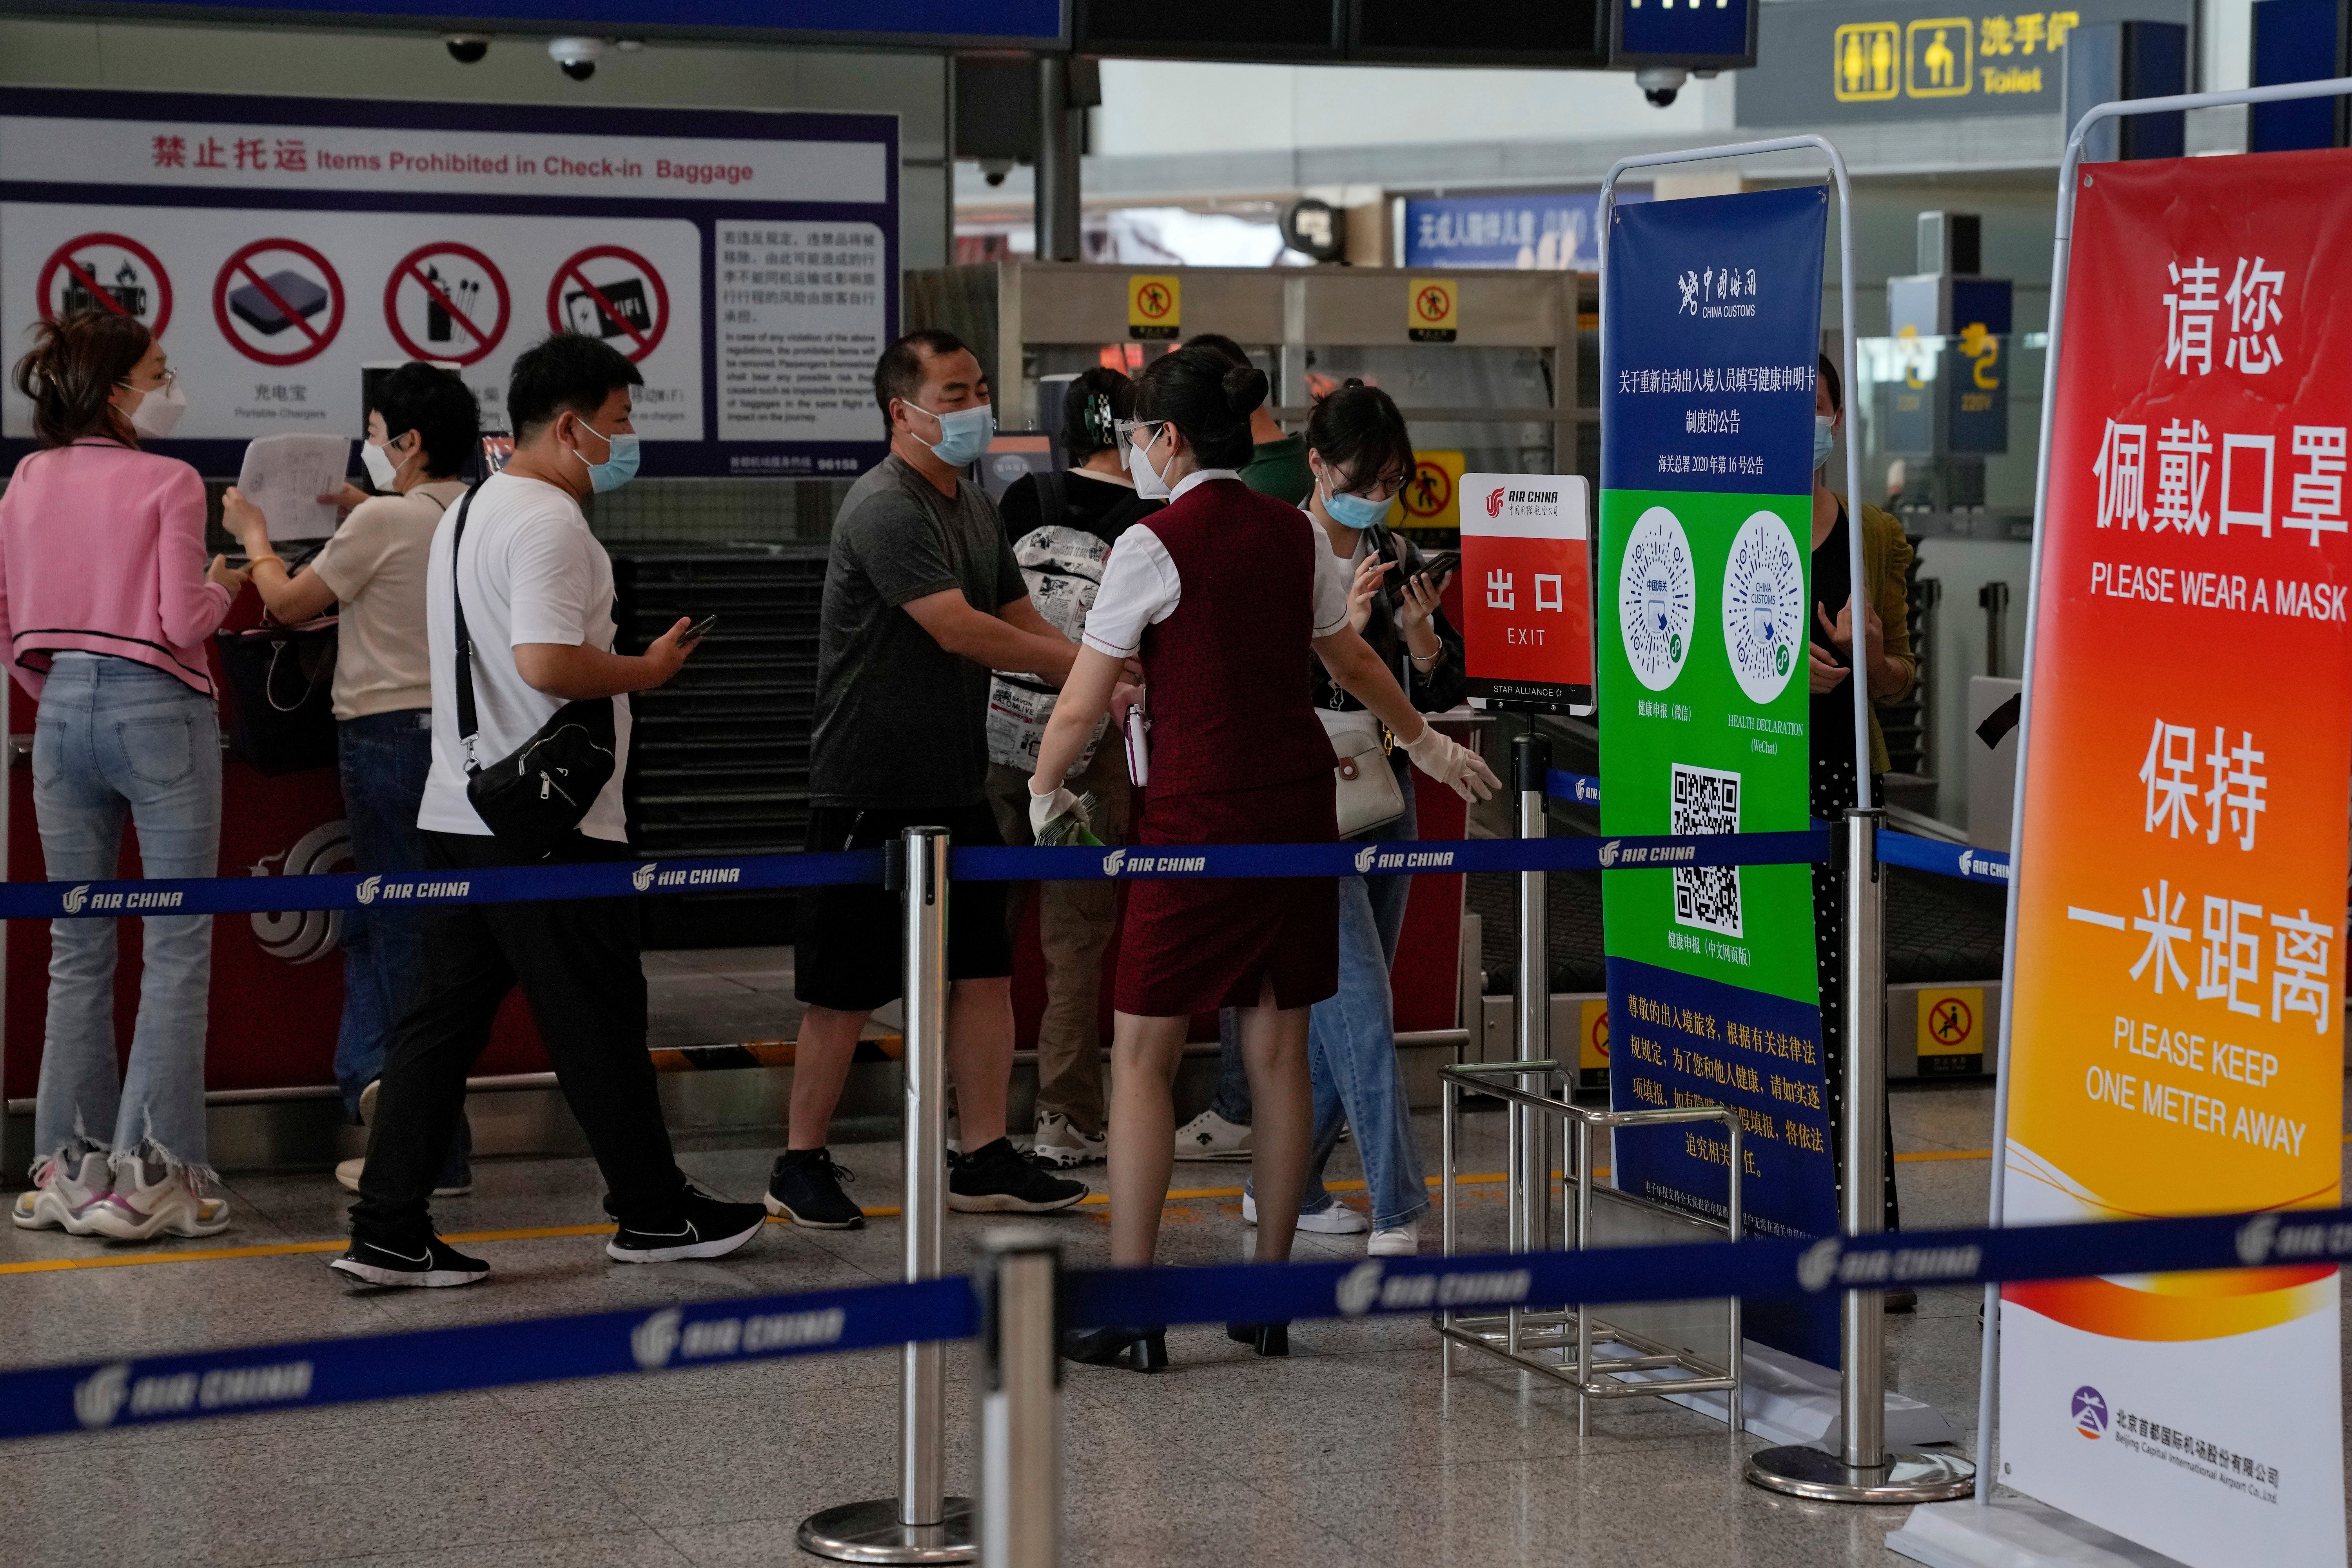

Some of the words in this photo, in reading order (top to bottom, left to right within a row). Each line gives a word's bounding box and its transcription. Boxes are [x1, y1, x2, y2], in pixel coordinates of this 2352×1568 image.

[1981, 66, 2043, 93] Toilet
[152, 135, 307, 172] 禁止托运
[317, 150, 381, 171] Items
[389, 151, 509, 175] Prohibited
[516, 155, 536, 174] in
[544, 155, 642, 178] Check-in
[656, 158, 753, 185] Baggage
[1702, 306, 1722, 319] CHINA
[1723, 304, 1755, 318] CUSTOMS
[2163, 256, 2286, 376] 请您
[1619, 365, 1815, 393] 关于重新启动出入境人员填写健康申明卡
[255, 383, 306, 402] 充电宝
[1685, 409, 1740, 434] 制度的公告
[817, 458, 858, 470] 96158
[1658, 454, 1690, 474] 海关总署
[1692, 456, 1708, 472] 2020
[1710, 455, 1726, 475] 年第
[1729, 457, 1736, 472] 16
[1739, 455, 1764, 475] 号公告
[2092, 417, 2348, 547] 佩戴口罩
[1508, 491, 1525, 502] AIR
[1528, 491, 1558, 503] CHINA
[1487, 569, 1563, 613] 出口
[1647, 579, 1667, 592] 中国海关
[1756, 583, 1771, 593] CHINA
[2091, 561, 2175, 603] PLEASE
[2181, 570, 2247, 612] WEAR
[2252, 578, 2269, 614] A
[2276, 580, 2347, 622] MASK
[1751, 593, 1776, 605] CUSTOMS
[1508, 628, 1545, 646] EXIT
[1494, 685, 1514, 695] STAR
[1515, 687, 1553, 697] ALLIANCE
[1638, 699, 1691, 722] 健康申报（微信）
[1728, 714, 1754, 730] HEALTH
[1757, 719, 1803, 736] DECLARATION
[1751, 739, 1778, 756] (WeChat)
[1586, 787, 1598, 800] AIR
[2139, 717, 2267, 851] 保持
[1126, 858, 1155, 872] AIR
[1158, 857, 1206, 872] CHINA
[1378, 853, 1405, 867] AIR
[1407, 851, 1454, 867] CHINA
[1621, 848, 1647, 862] AIR
[1650, 846, 1695, 861] CHINA
[657, 870, 687, 886] AIR
[689, 867, 740, 885] CHINA
[1973, 860, 1989, 876] AIR
[1989, 862, 2010, 879] CHIN
[91, 893, 122, 909] AIR
[126, 891, 183, 908] CHINA
[383, 884, 412, 899] AIR
[416, 881, 470, 898] CHINA
[1668, 929, 1751, 968] 健康申报（中文网页版）
[2067, 879, 2334, 1035] 一米距离
[1628, 993, 1817, 1065] 尊敬的出入境旅客，根据有关法律法
[2114, 1015, 2205, 1072] PLEASE
[2212, 1040, 2279, 1088] KEEP
[1630, 1034, 1821, 1110] 规规定，为了您和他人健康，请如实逐
[2086, 1065, 2136, 1111] ONE
[2143, 1080, 2226, 1136] METER
[2232, 1106, 2307, 1157] AWAY
[1686, 1132, 1761, 1178] 追究相关任。
[1842, 1250, 1891, 1281] AIR
[1893, 1246, 1982, 1278] CHINA
[1381, 1275, 1434, 1307] AIR
[1439, 1269, 1530, 1305] CHINA
[680, 1317, 741, 1360] AIR
[744, 1308, 844, 1355] CHINA
[130, 1371, 194, 1416] AIR
[199, 1361, 313, 1407] CHINA
[2116, 1408, 2279, 1489] 北京首都国际机场股份有限公司
[2115, 1430, 2140, 1453] Beijing
[2141, 1441, 2167, 1461] Capital
[2168, 1453, 2217, 1481] International
[2218, 1472, 2247, 1494] Airport
